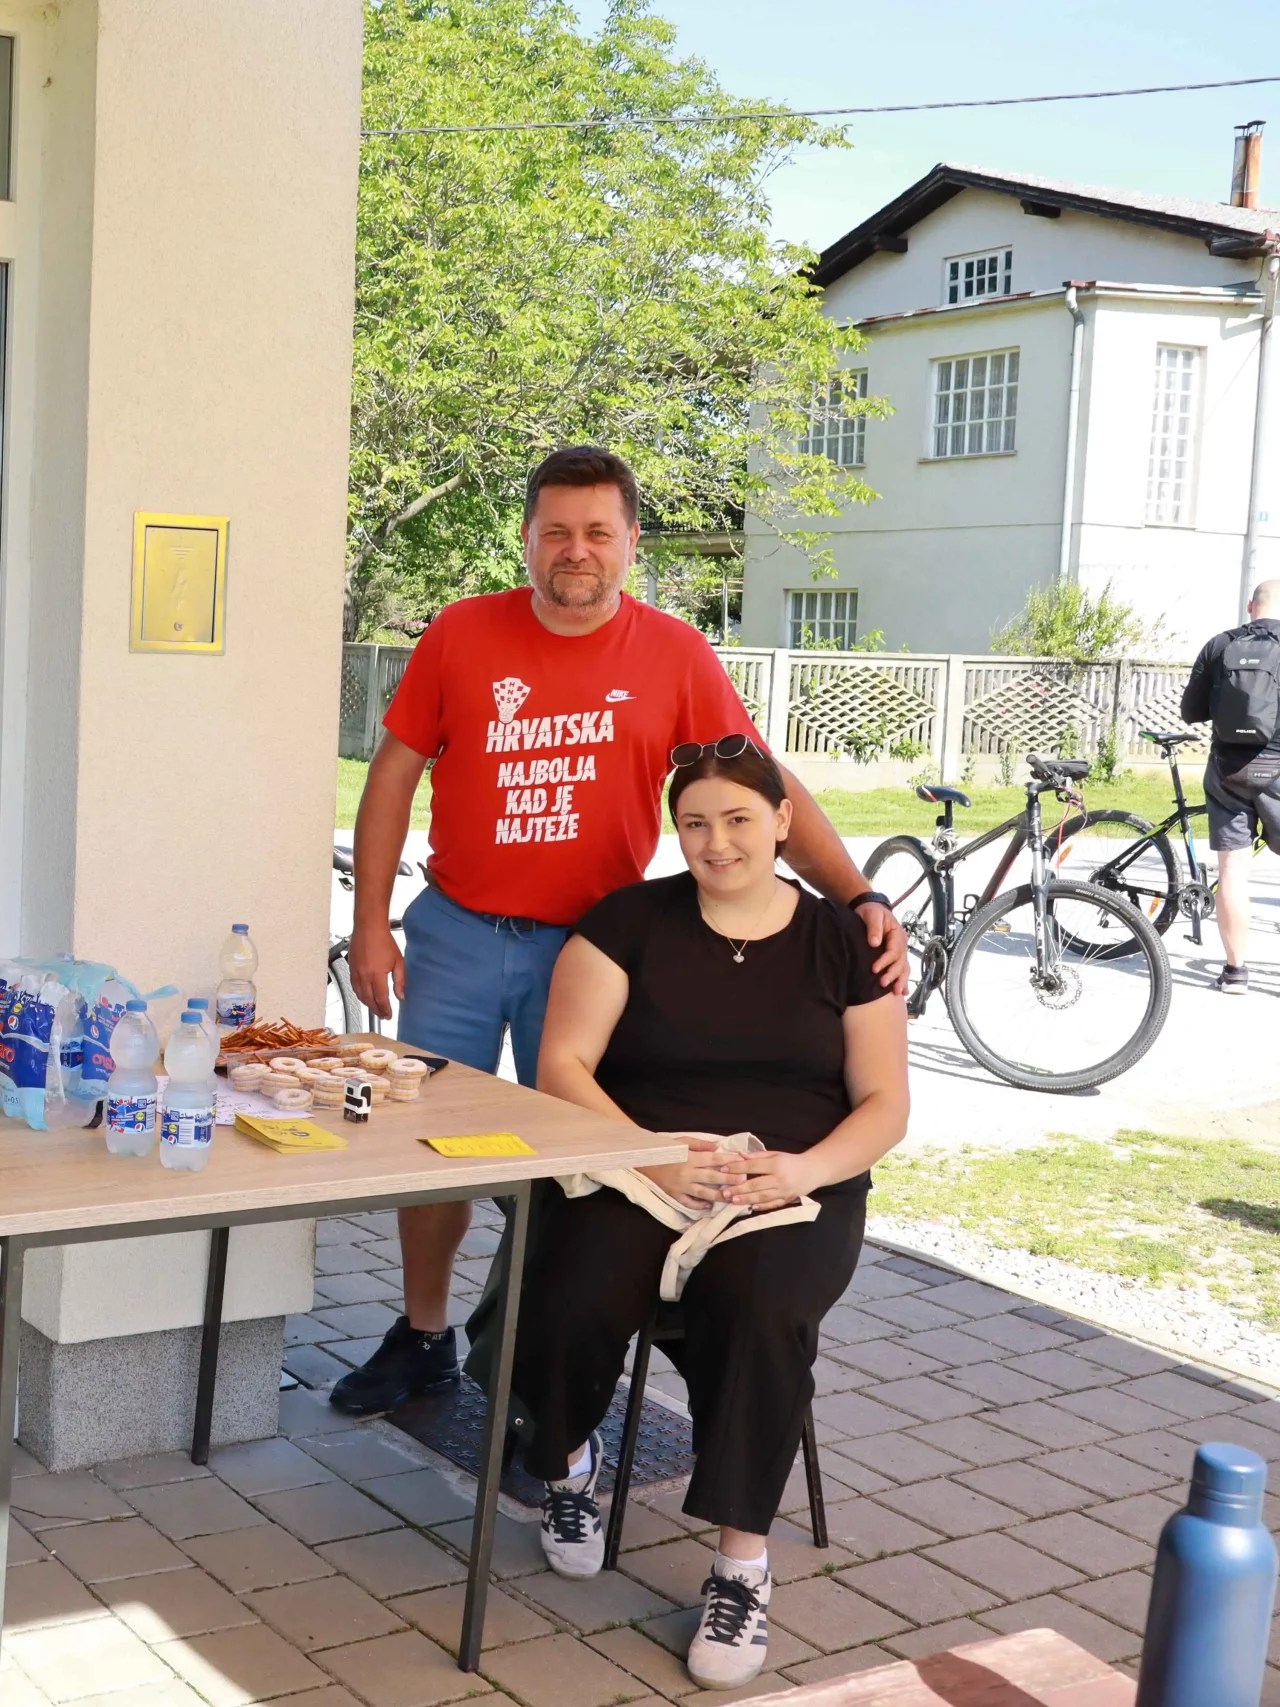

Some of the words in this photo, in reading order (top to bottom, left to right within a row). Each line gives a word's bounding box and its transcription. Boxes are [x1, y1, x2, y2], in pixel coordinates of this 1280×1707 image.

[610, 689, 629, 697] NIKE
[486, 710, 614, 752] HRVATSKA
[497, 755, 596, 788] NAJBOLJA
[505, 788, 548, 815] KAD
[551, 785, 574, 813] JE
[495, 810, 580, 845] NAJTEŽE
